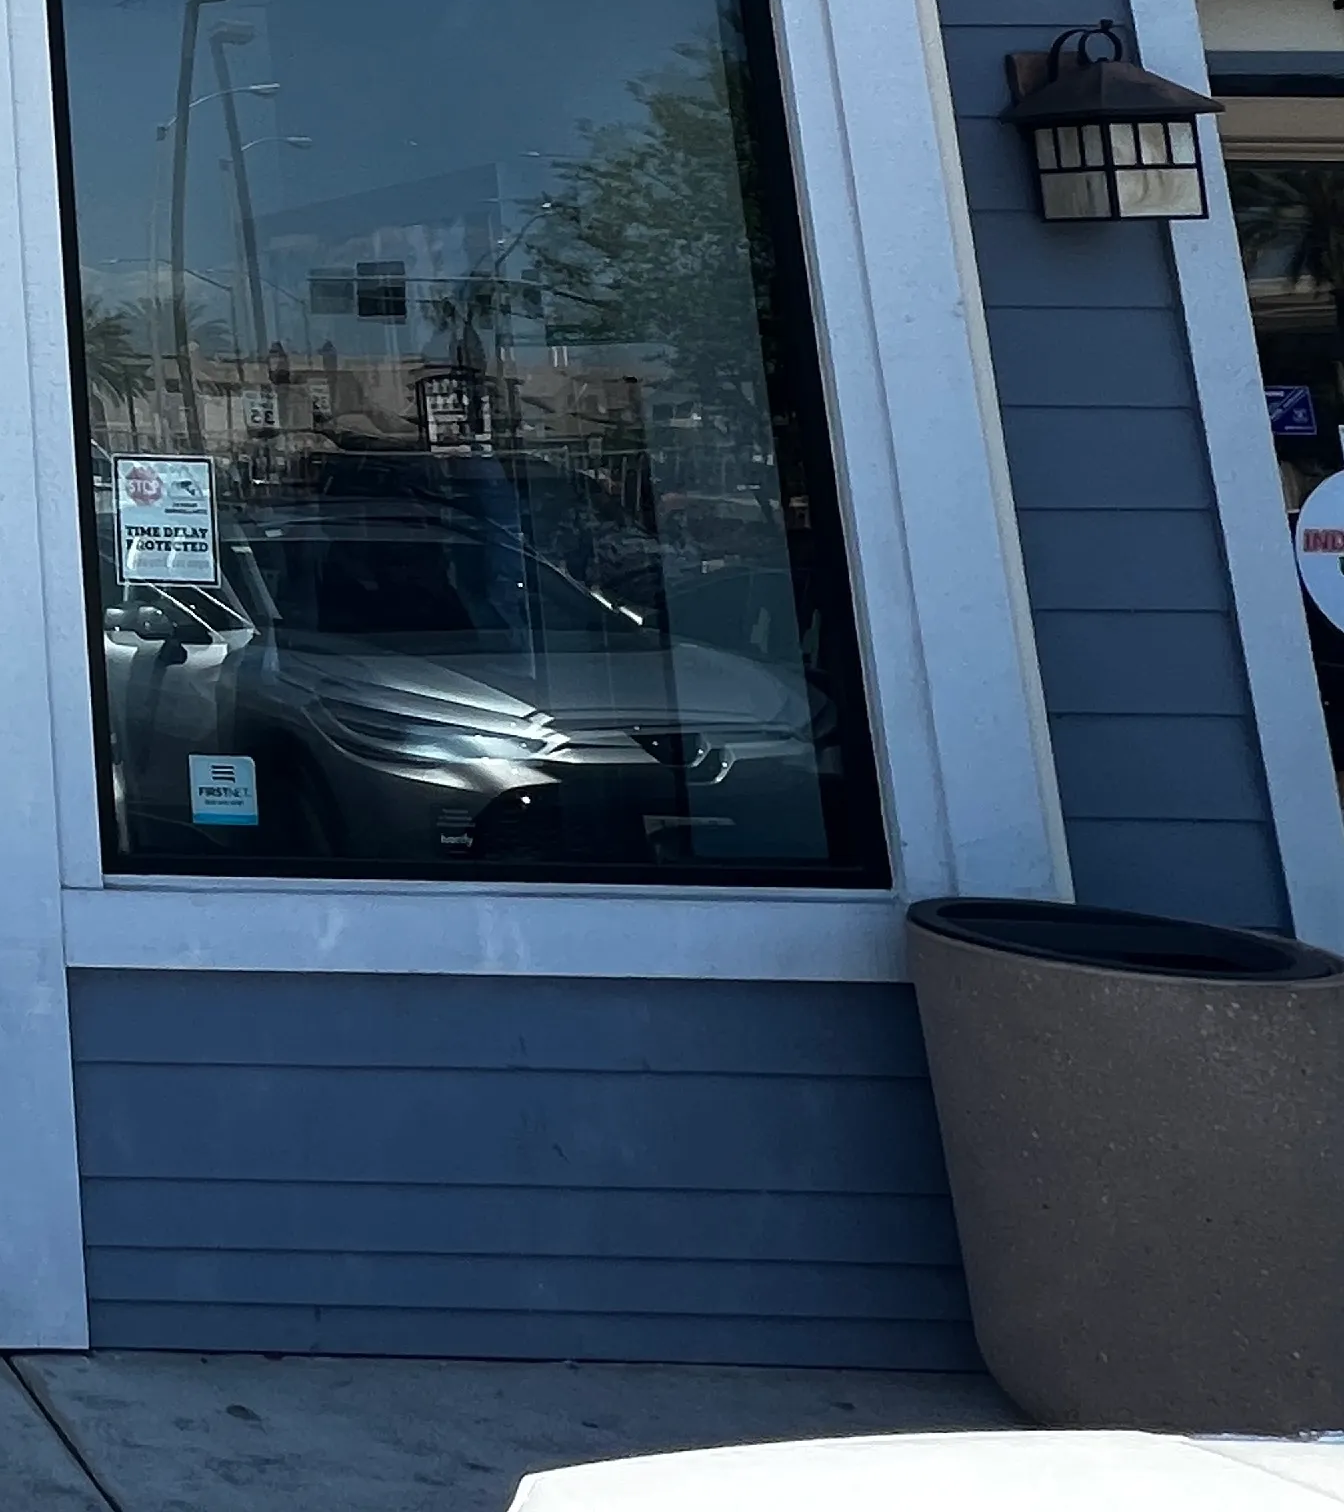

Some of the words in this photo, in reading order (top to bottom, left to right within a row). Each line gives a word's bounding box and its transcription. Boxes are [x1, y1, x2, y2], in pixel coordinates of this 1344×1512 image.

[129, 478, 160, 495] STOP
[125, 525, 161, 538] TIME
[163, 526, 209, 539] DELAY
